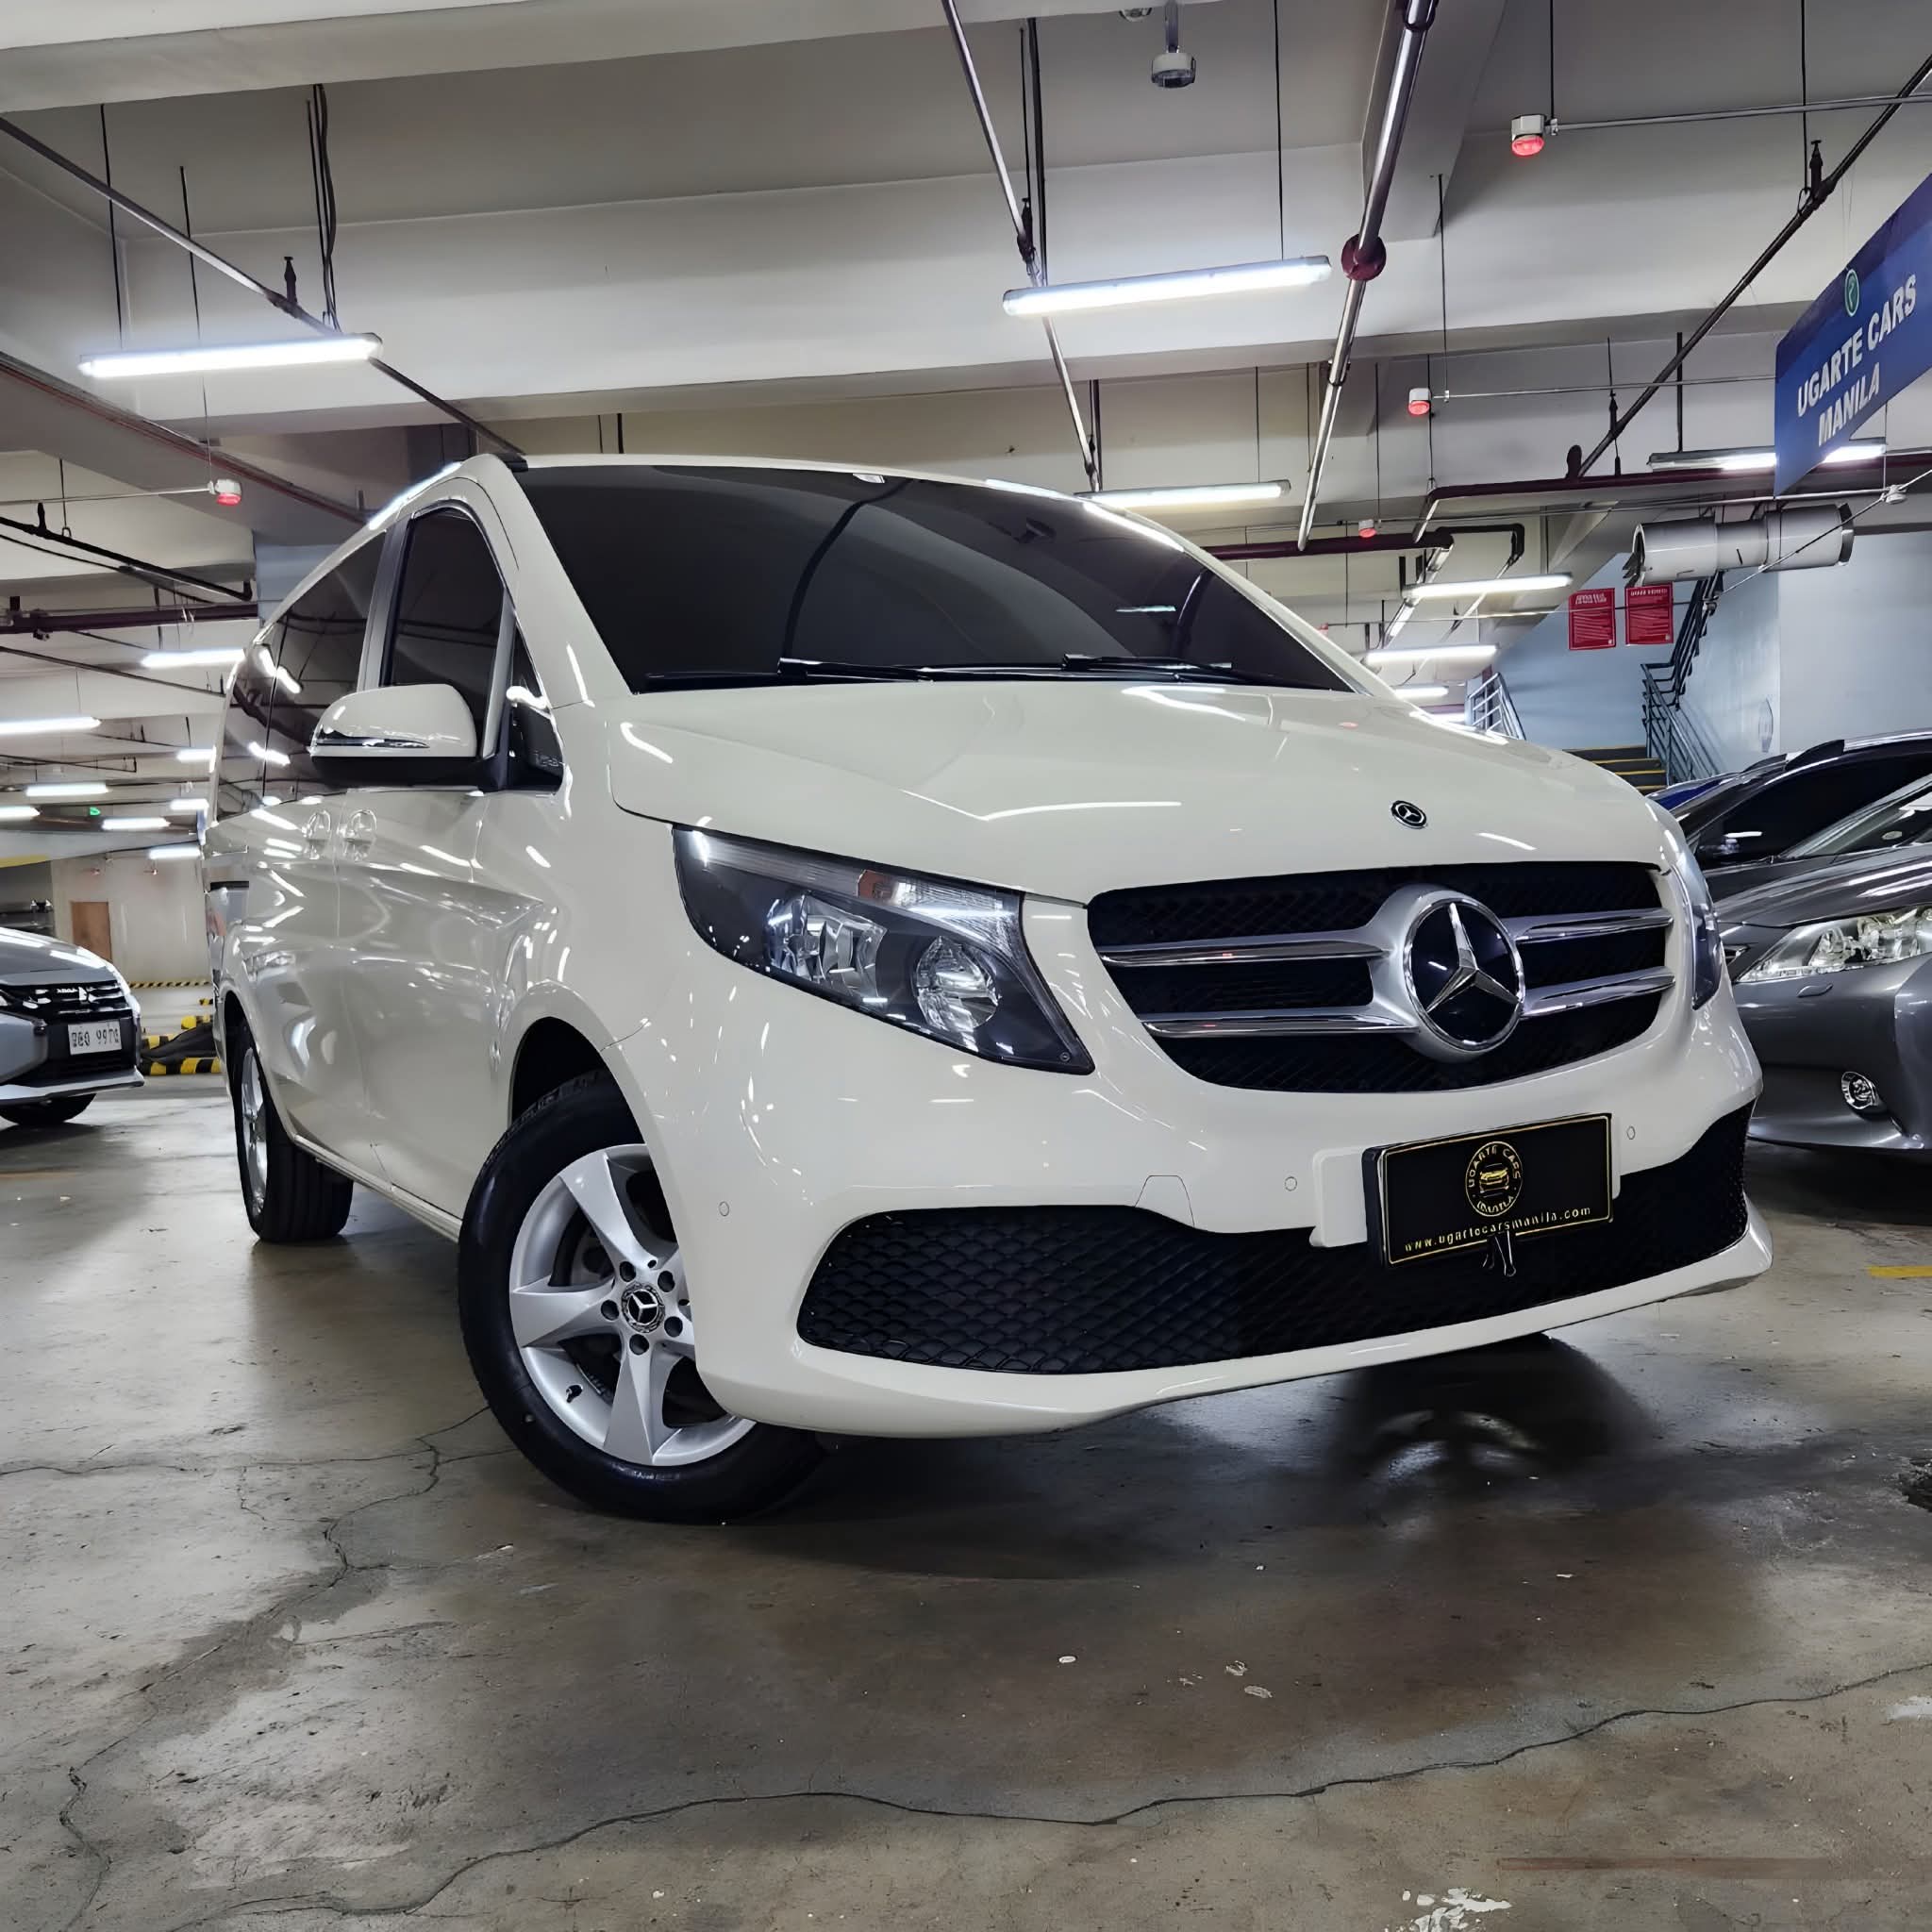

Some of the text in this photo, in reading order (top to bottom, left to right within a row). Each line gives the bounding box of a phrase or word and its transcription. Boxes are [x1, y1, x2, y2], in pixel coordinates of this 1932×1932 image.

[1797, 274, 1916, 417] UGARTE CARS
[1819, 362, 1880, 447] MANILA
[1502, 1148, 1521, 1179] CARS
